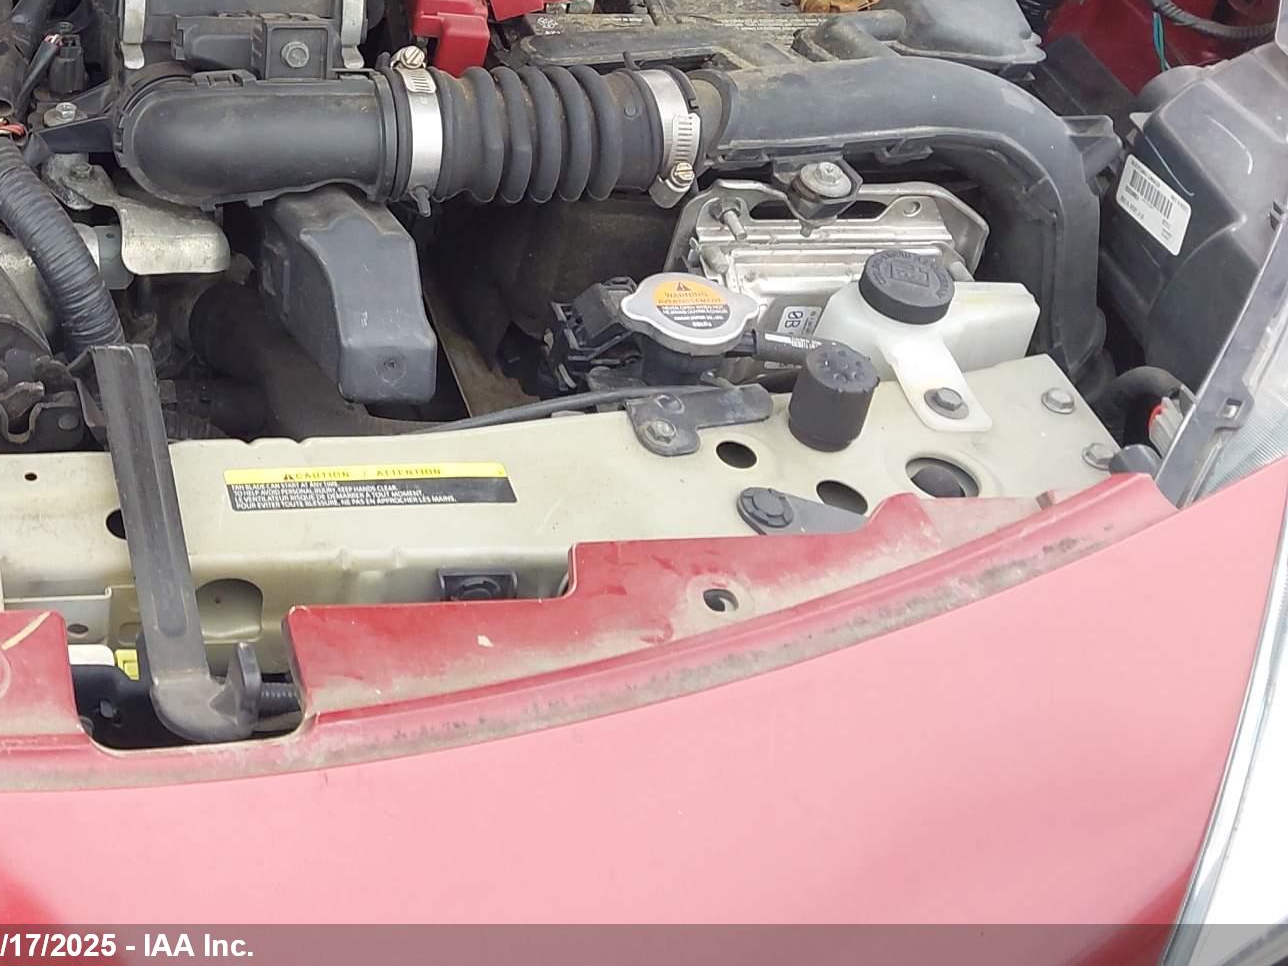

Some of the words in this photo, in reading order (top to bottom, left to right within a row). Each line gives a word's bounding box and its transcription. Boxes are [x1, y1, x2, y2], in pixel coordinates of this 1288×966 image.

[664, 291, 708, 299] WARNING
[295, 471, 350, 480] CAUTION
[376, 467, 442, 477] ATTENTION
[244, 482, 264, 490] BLADE
[265, 482, 280, 490] CAN
[280, 481, 300, 489] START
[309, 480, 322, 488] ANY
[260, 488, 280, 496] AVOID
[280, 487, 312, 495] PERSONAL
[337, 485, 353, 493] KEEP
[243, 495, 289, 503] VENTILATEUR
[315, 493, 326, 501] DE
[340, 498, 351, 506] NE
[352, 497, 365, 505] PAS
[365, 497, 376, 505] EN
[376, 496, 418, 505] APPROCHER
